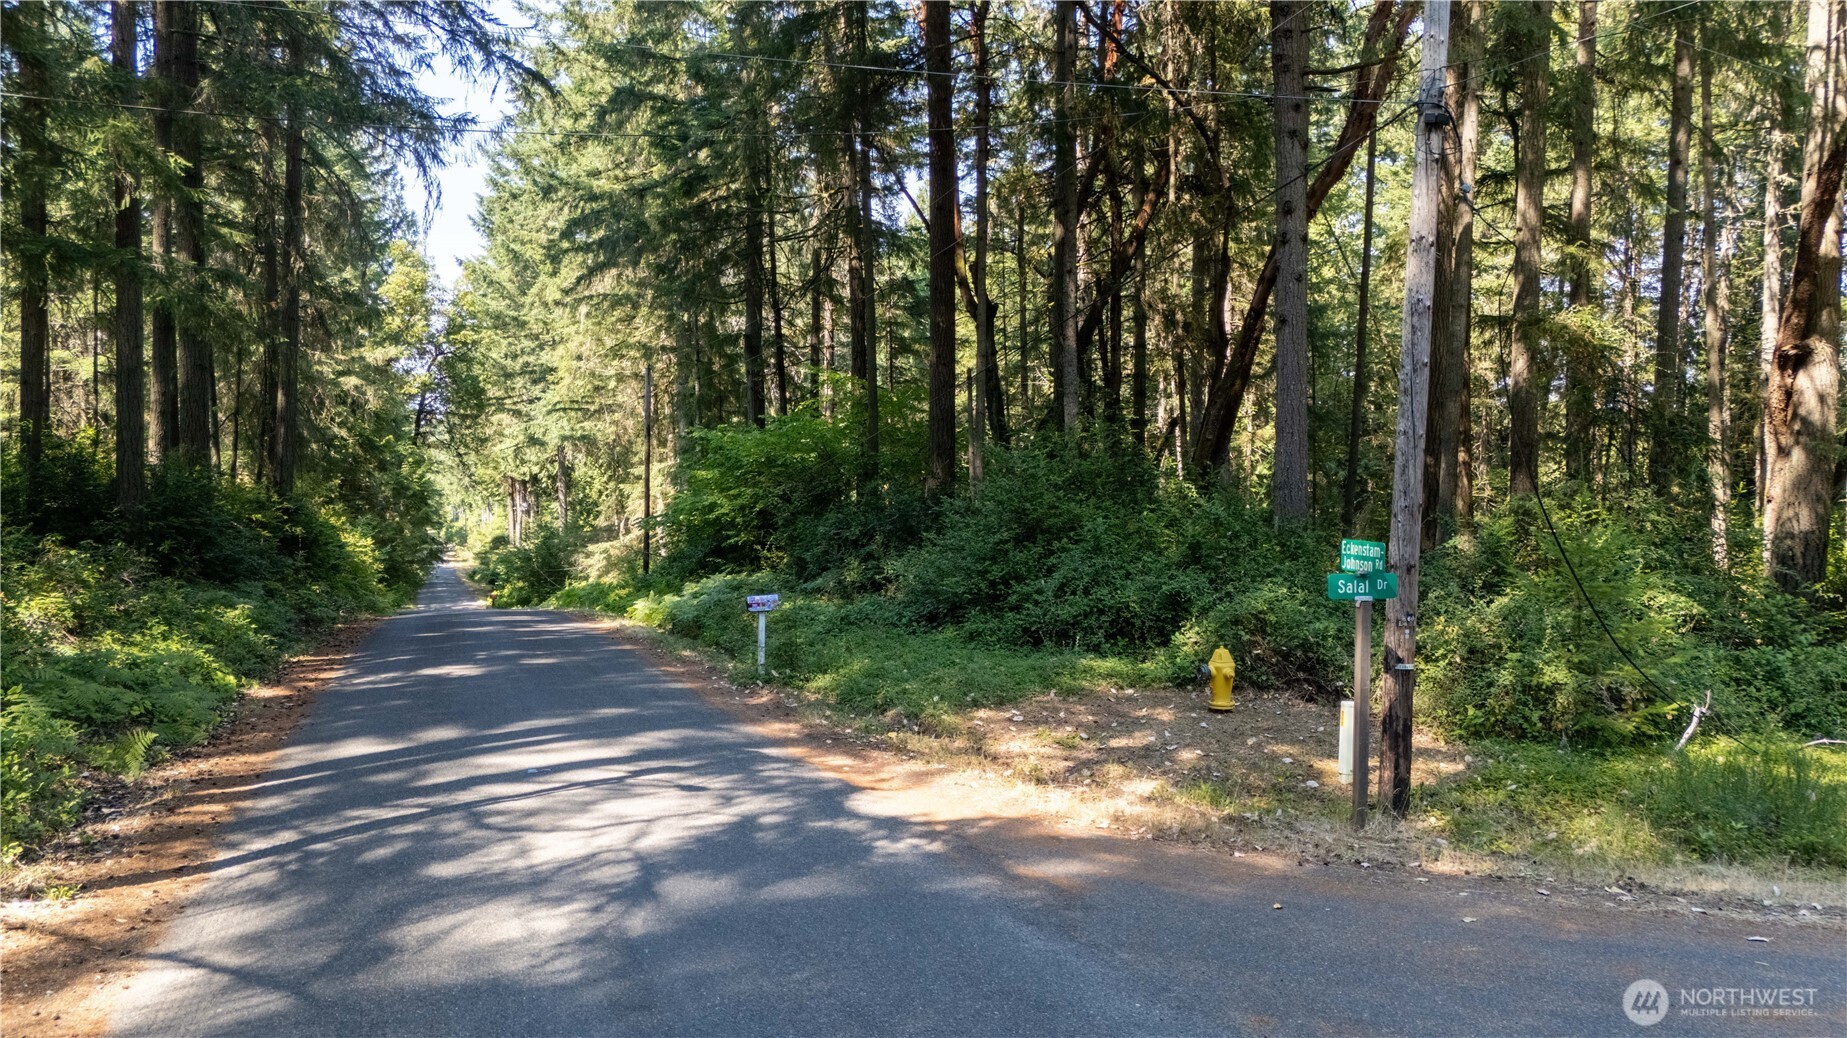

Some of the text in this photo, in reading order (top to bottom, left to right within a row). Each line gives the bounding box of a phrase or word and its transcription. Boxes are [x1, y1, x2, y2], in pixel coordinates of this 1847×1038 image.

[1341, 540, 1384, 558] Eckenstam-
[1341, 556, 1383, 572] Johnson Rd
[1337, 579, 1388, 594] Salal Dr
